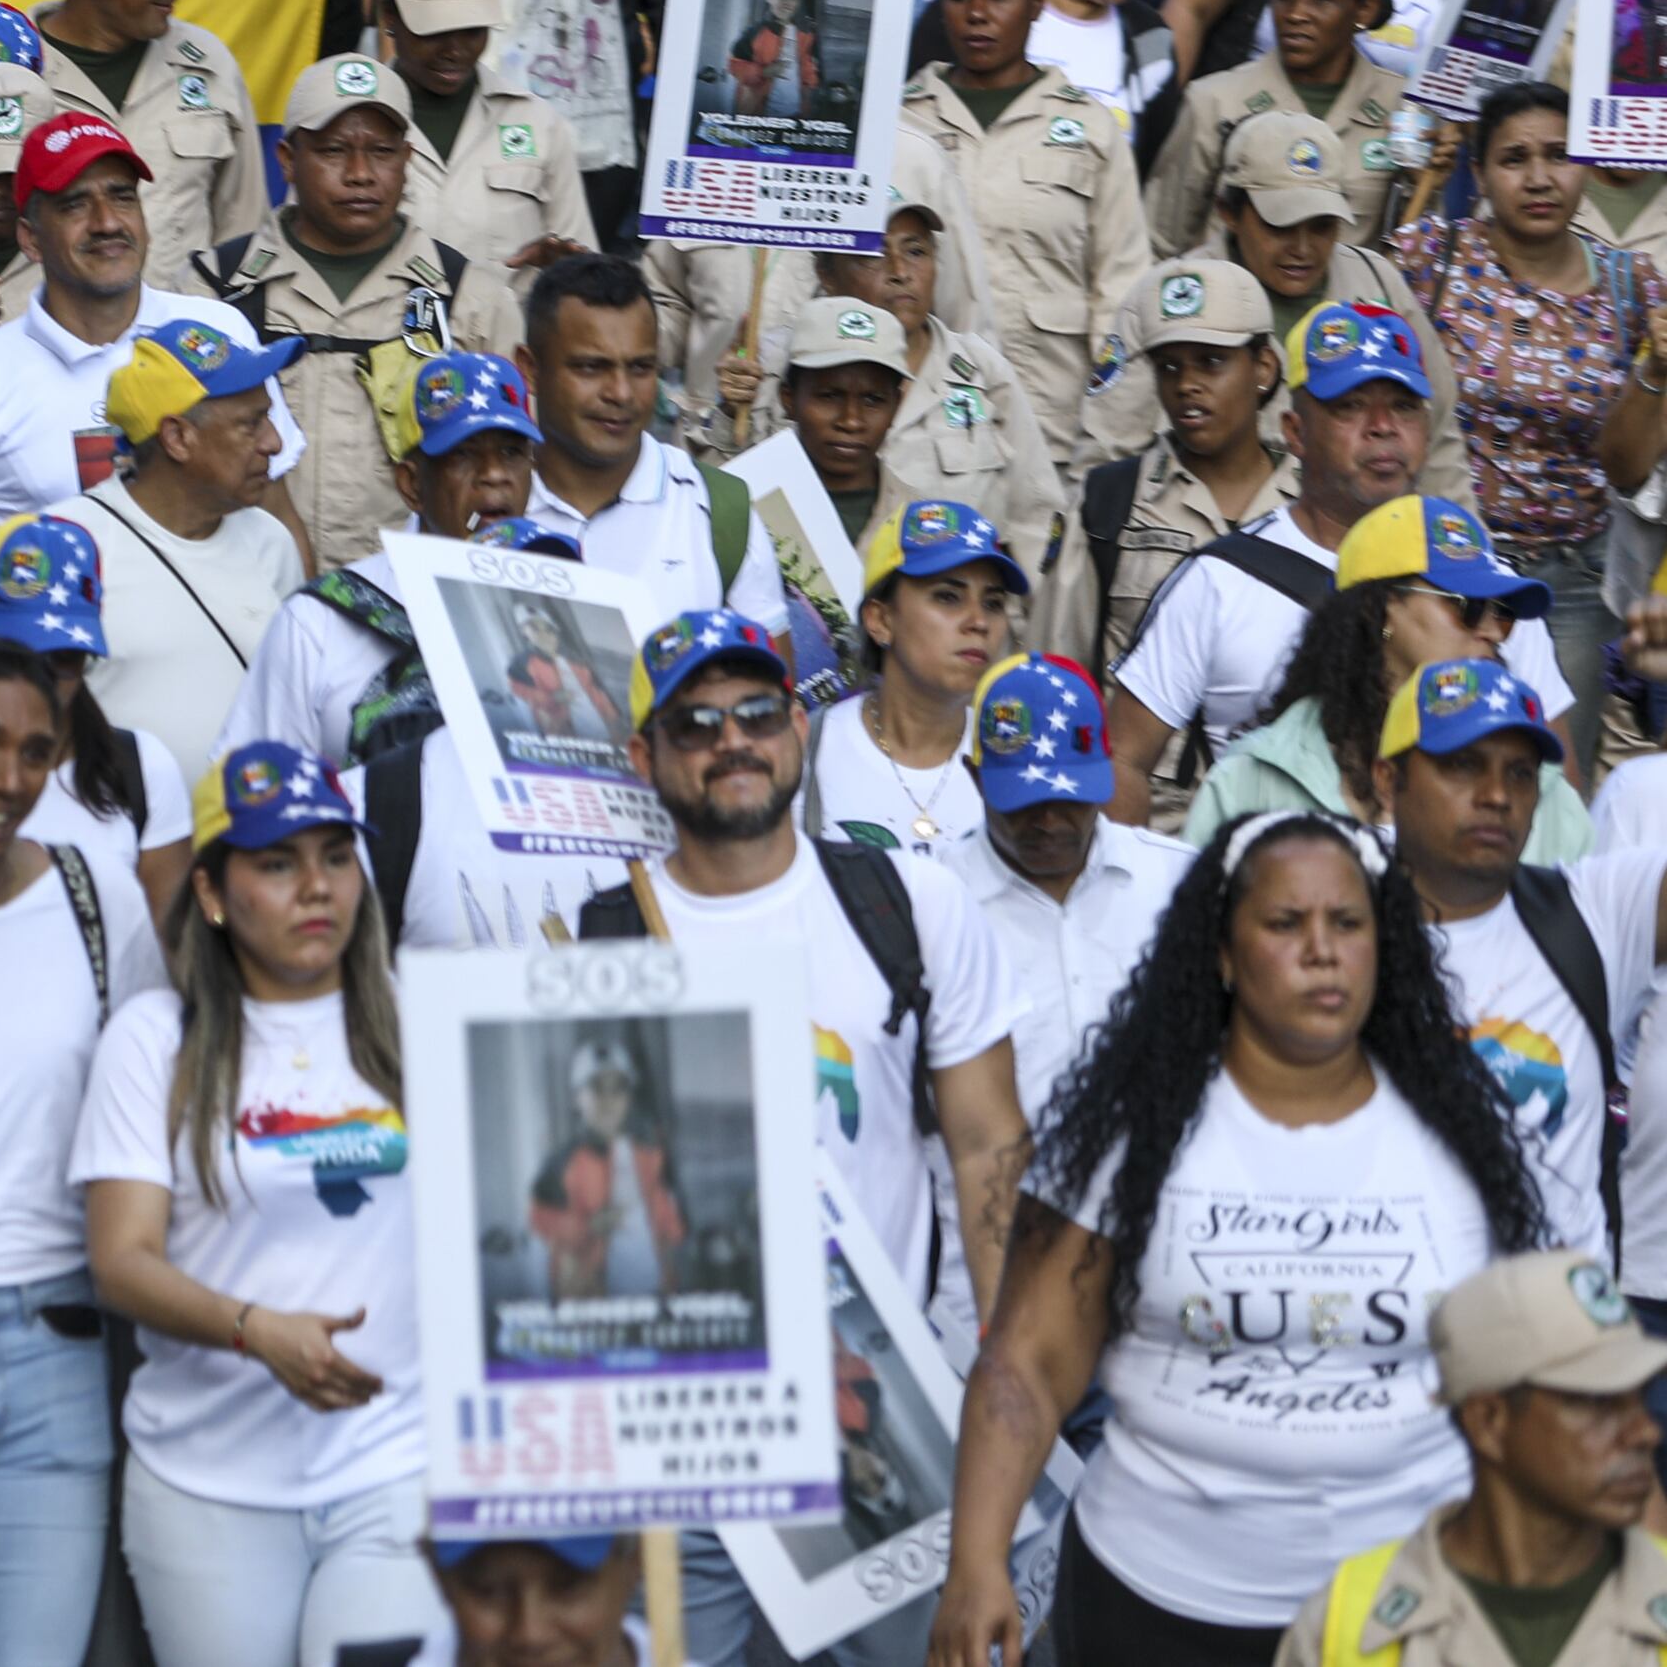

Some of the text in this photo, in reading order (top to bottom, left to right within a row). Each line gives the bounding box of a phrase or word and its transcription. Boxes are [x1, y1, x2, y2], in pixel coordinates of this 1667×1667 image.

[698, 112, 853, 134] YOLEINER YOEL
[661, 160, 756, 217] USA
[760, 165, 872, 188] LIBEREN A
[758, 185, 868, 207] NUESTROS
[780, 205, 841, 223] HIJOS
[665, 221, 857, 248] #FREEOURCHILDREN
[467, 548, 574, 596] SOS
[490, 776, 617, 836] USA
[527, 948, 684, 1013] SOS
[1223, 1262, 1384, 1279] CALIFORNIA
[618, 1383, 798, 1412] LIBEREN A
[1195, 1375, 1391, 1421] Angeles
[456, 1385, 614, 1488] USA
[618, 1414, 798, 1442] NUESTROS
[662, 1452, 760, 1477] HIJOS
